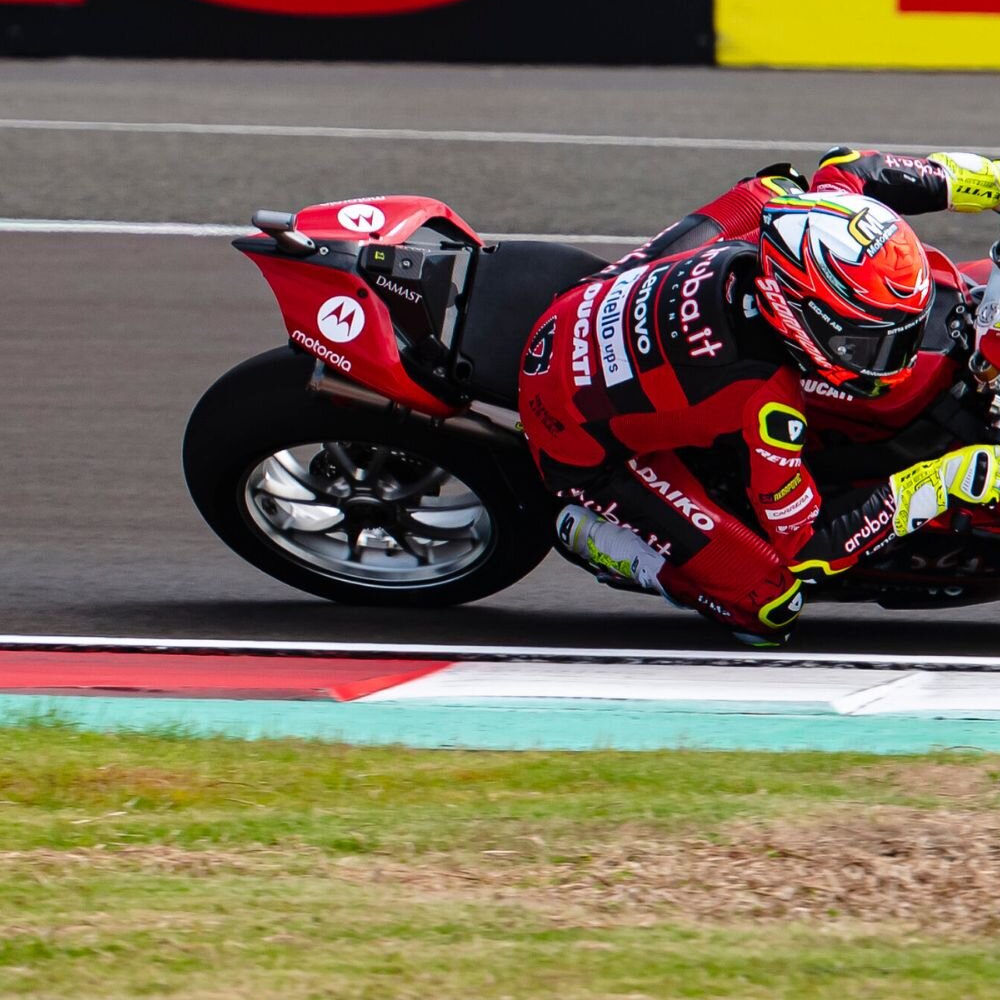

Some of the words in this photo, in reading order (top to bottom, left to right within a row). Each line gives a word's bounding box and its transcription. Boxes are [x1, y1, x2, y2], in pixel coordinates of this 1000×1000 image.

[375, 274, 423, 304] DAMAST
[634, 263, 671, 355] Lenovo
[571, 282, 604, 387] DUCATI
[601, 285, 626, 340] riello
[291, 329, 352, 373] motorola
[602, 344, 620, 374] ups
[772, 493, 809, 517] CARRERA
